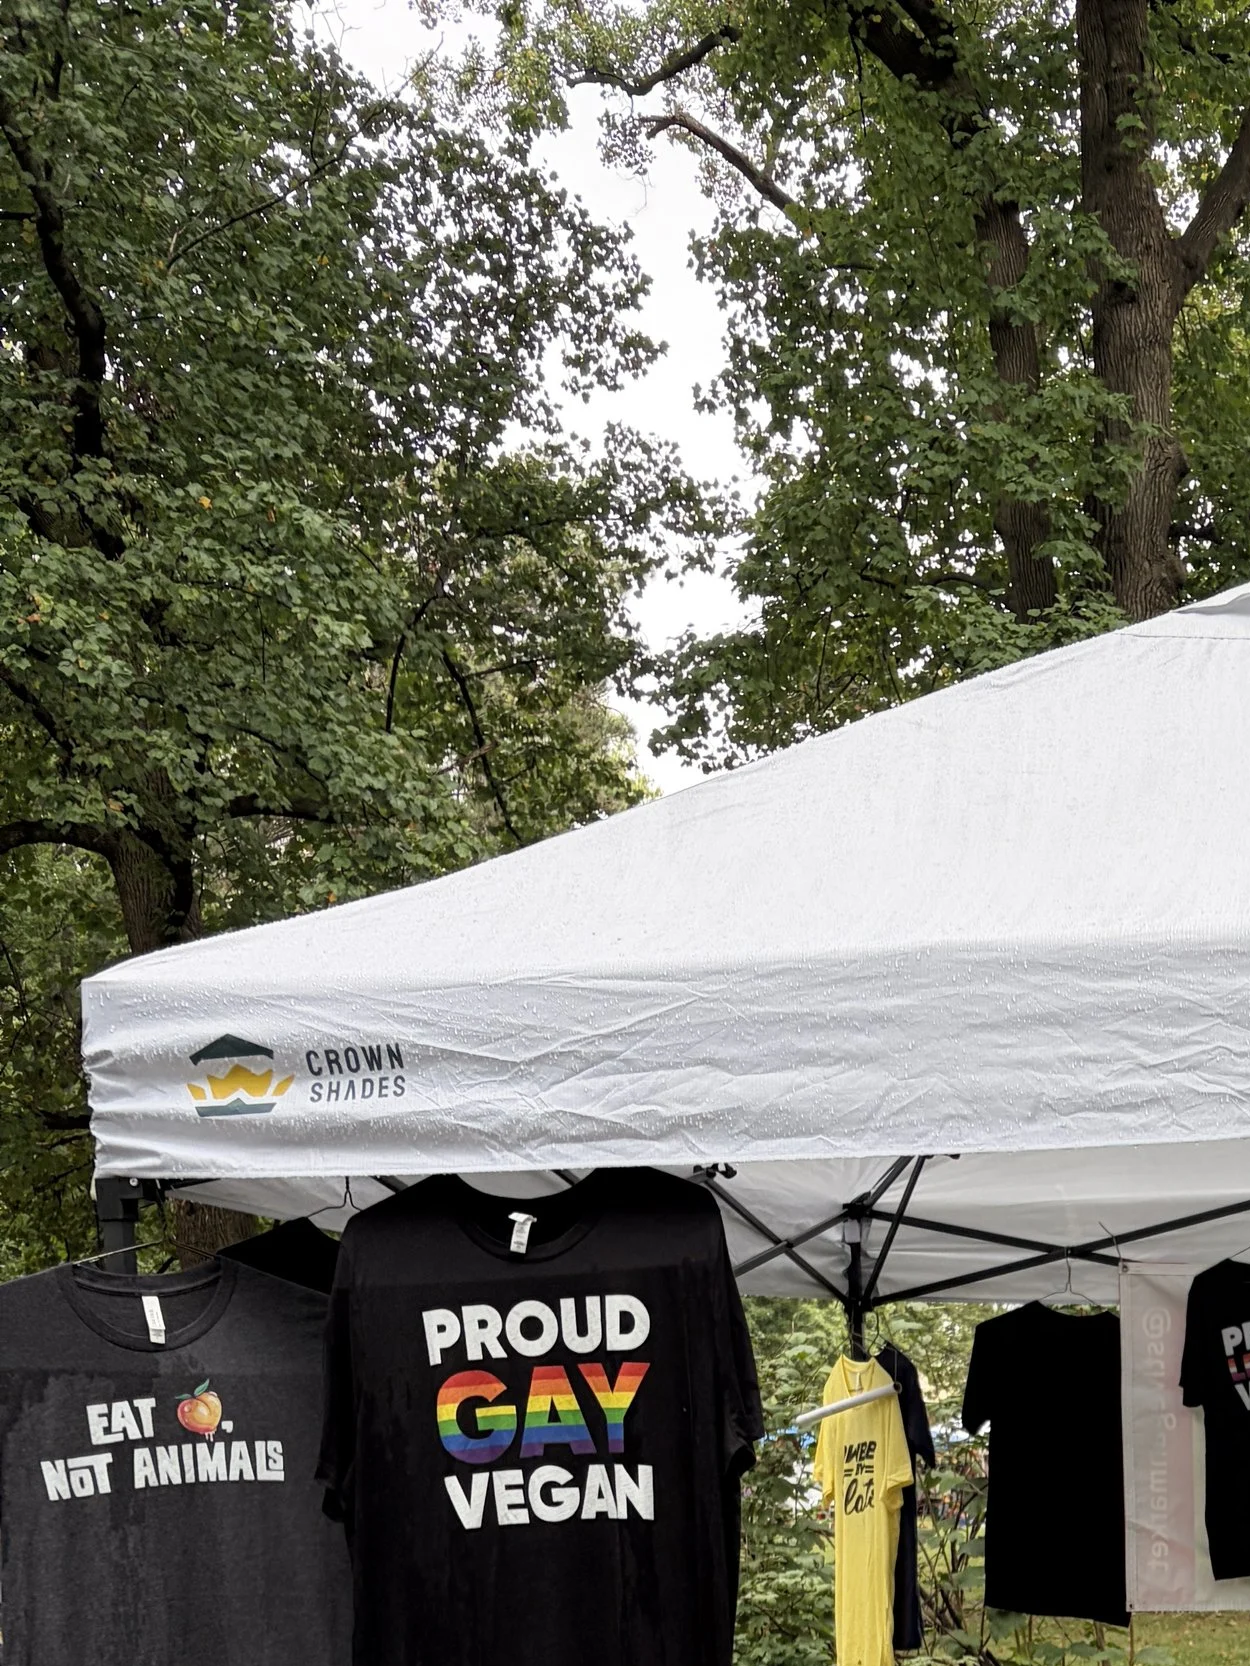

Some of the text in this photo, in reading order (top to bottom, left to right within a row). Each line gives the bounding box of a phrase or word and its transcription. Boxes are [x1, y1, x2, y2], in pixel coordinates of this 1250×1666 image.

[305, 1043, 404, 1076] CROWN
[309, 1075, 406, 1103] SHADES
[421, 1294, 652, 1367] PROUD
[86, 1398, 156, 1445] EAT
[435, 1361, 651, 1465] GAY
[133, 1440, 285, 1489] ANIMALS
[443, 1464, 655, 1530] VEGAN
